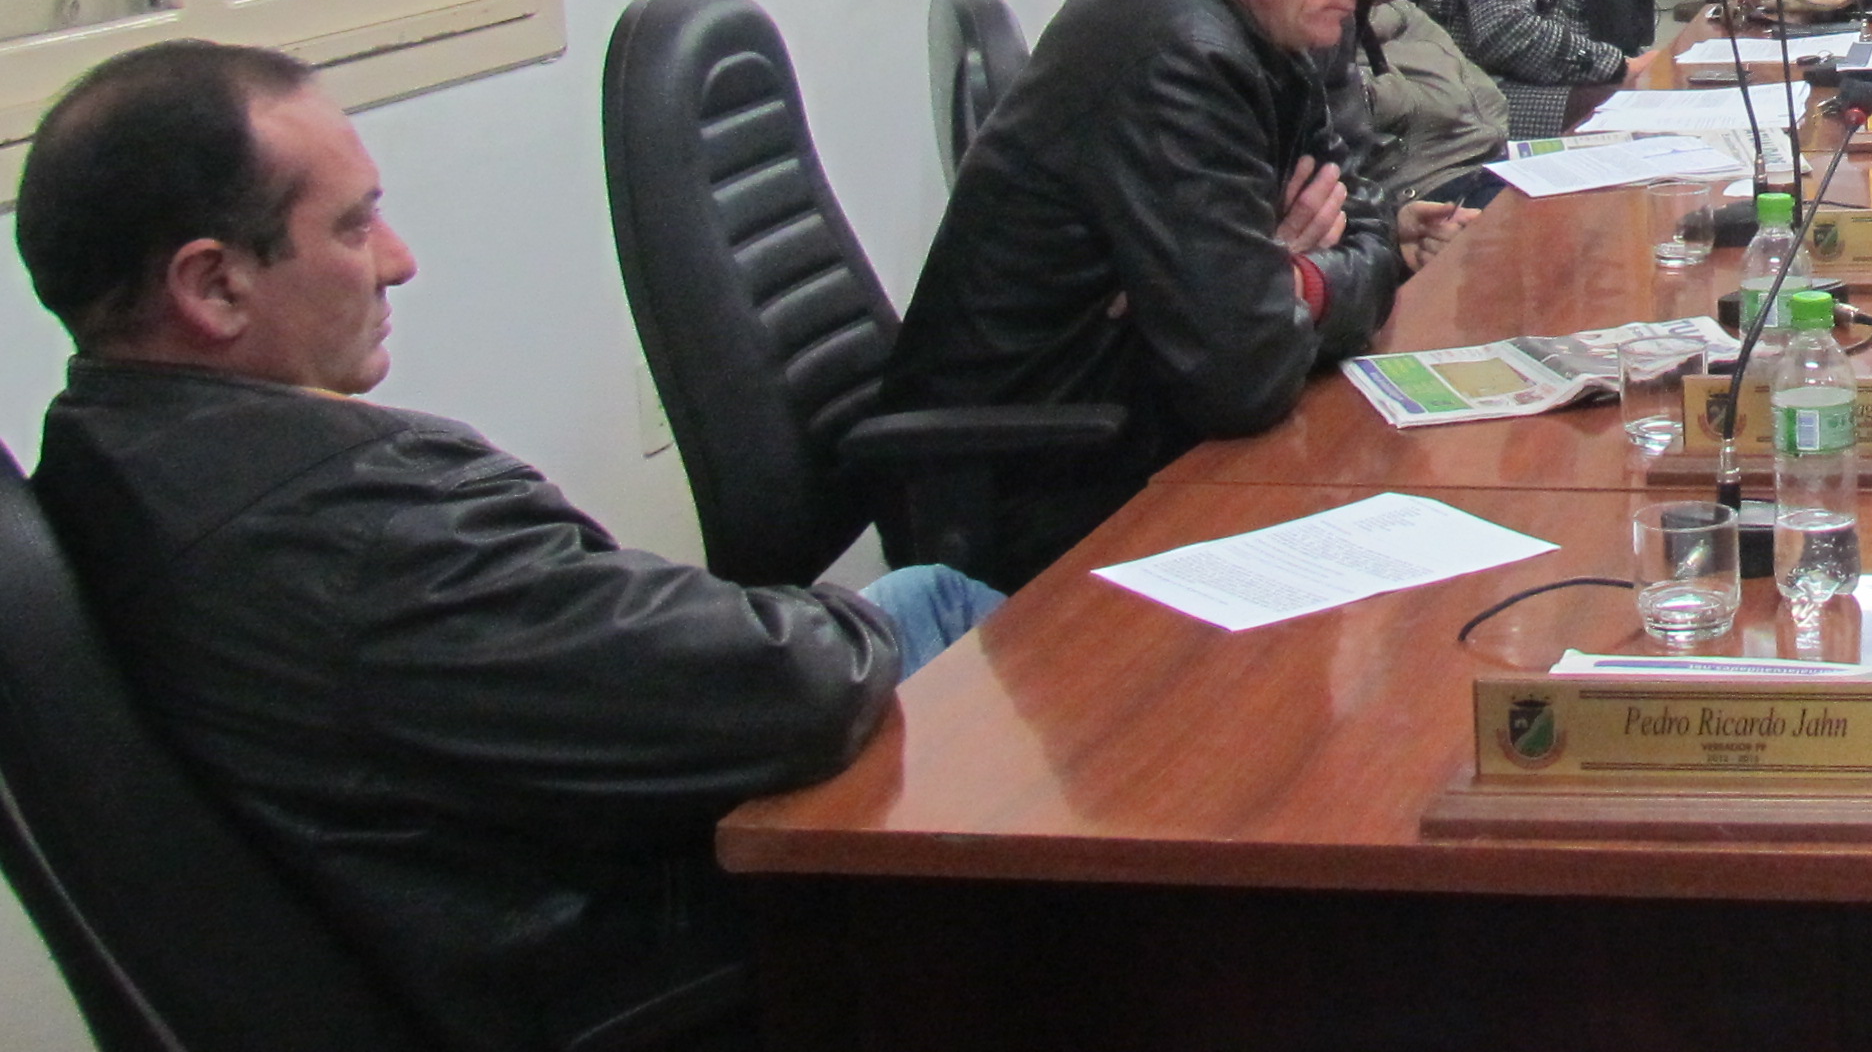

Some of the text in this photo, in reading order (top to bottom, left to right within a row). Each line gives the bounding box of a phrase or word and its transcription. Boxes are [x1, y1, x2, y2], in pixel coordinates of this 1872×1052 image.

[1624, 706, 1849, 739] Pedro Ricardo Jahn
